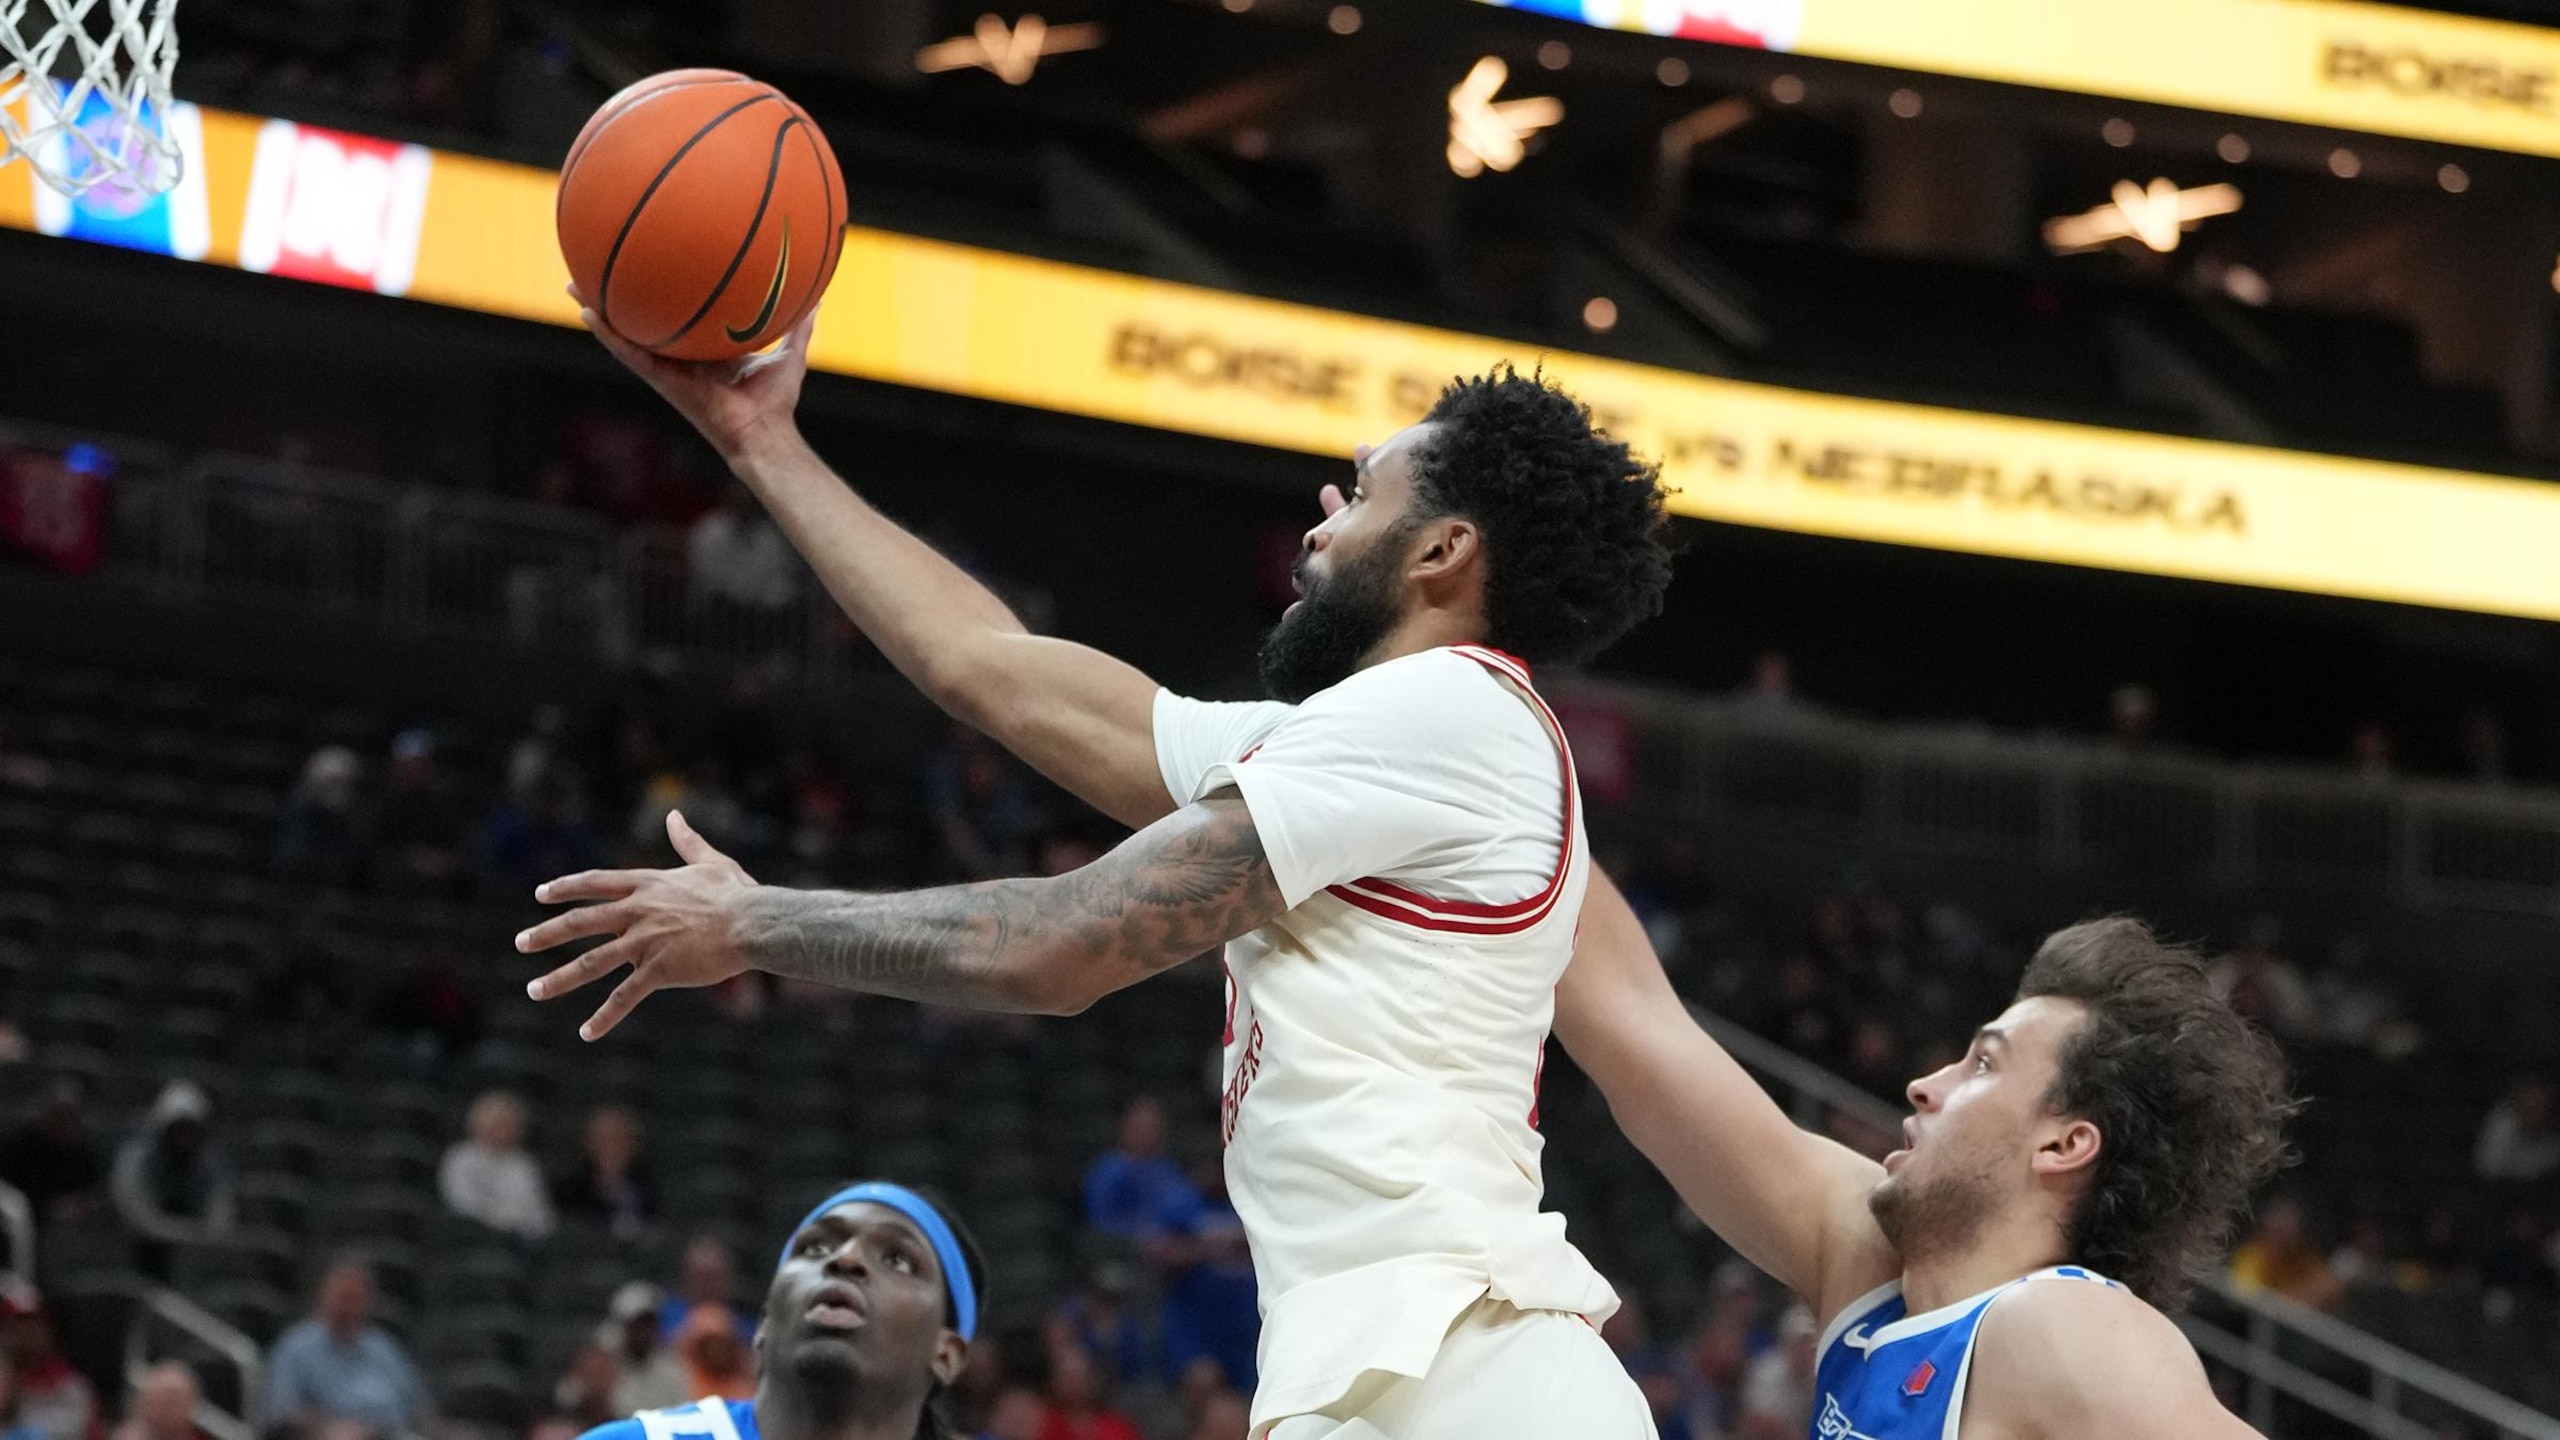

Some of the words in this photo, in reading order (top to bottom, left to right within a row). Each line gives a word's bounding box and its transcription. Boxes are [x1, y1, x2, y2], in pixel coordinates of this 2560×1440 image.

[2321, 43, 2557, 115] BOISE
[1110, 322, 1355, 411] BOISE
[1766, 433, 2246, 537] NEBRASKA
